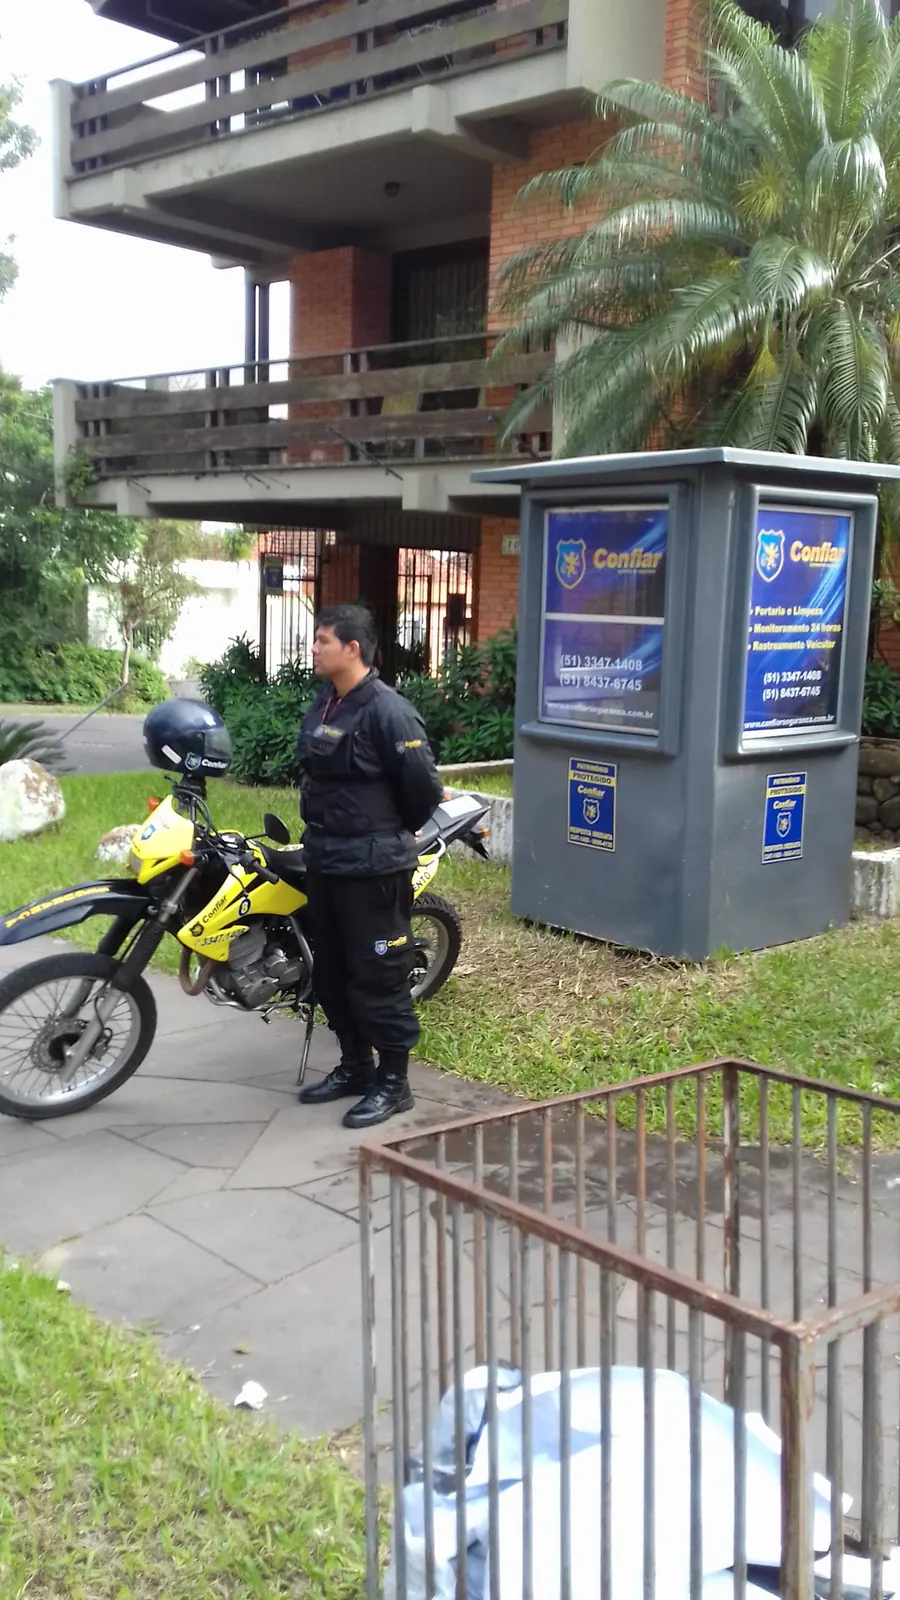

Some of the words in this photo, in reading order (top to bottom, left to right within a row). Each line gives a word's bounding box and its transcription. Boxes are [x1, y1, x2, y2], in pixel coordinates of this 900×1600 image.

[593, 548, 663, 569] Confiar
[790, 540, 845, 562] Confiar
[754, 606, 786, 616] Portaria
[753, 623, 810, 633] Monitoramento
[560, 655, 581, 668] (51)
[584, 656, 643, 671] 3347-1408
[560, 674, 581, 689] (51)
[583, 675, 642, 691] 8437-6745
[763, 672, 780, 685] (51)
[781, 670, 822, 682] 3347-1408
[762, 688, 779, 702] (51)
[780, 686, 821, 699] 8437-6745
[202, 895, 227, 924] Confiar
